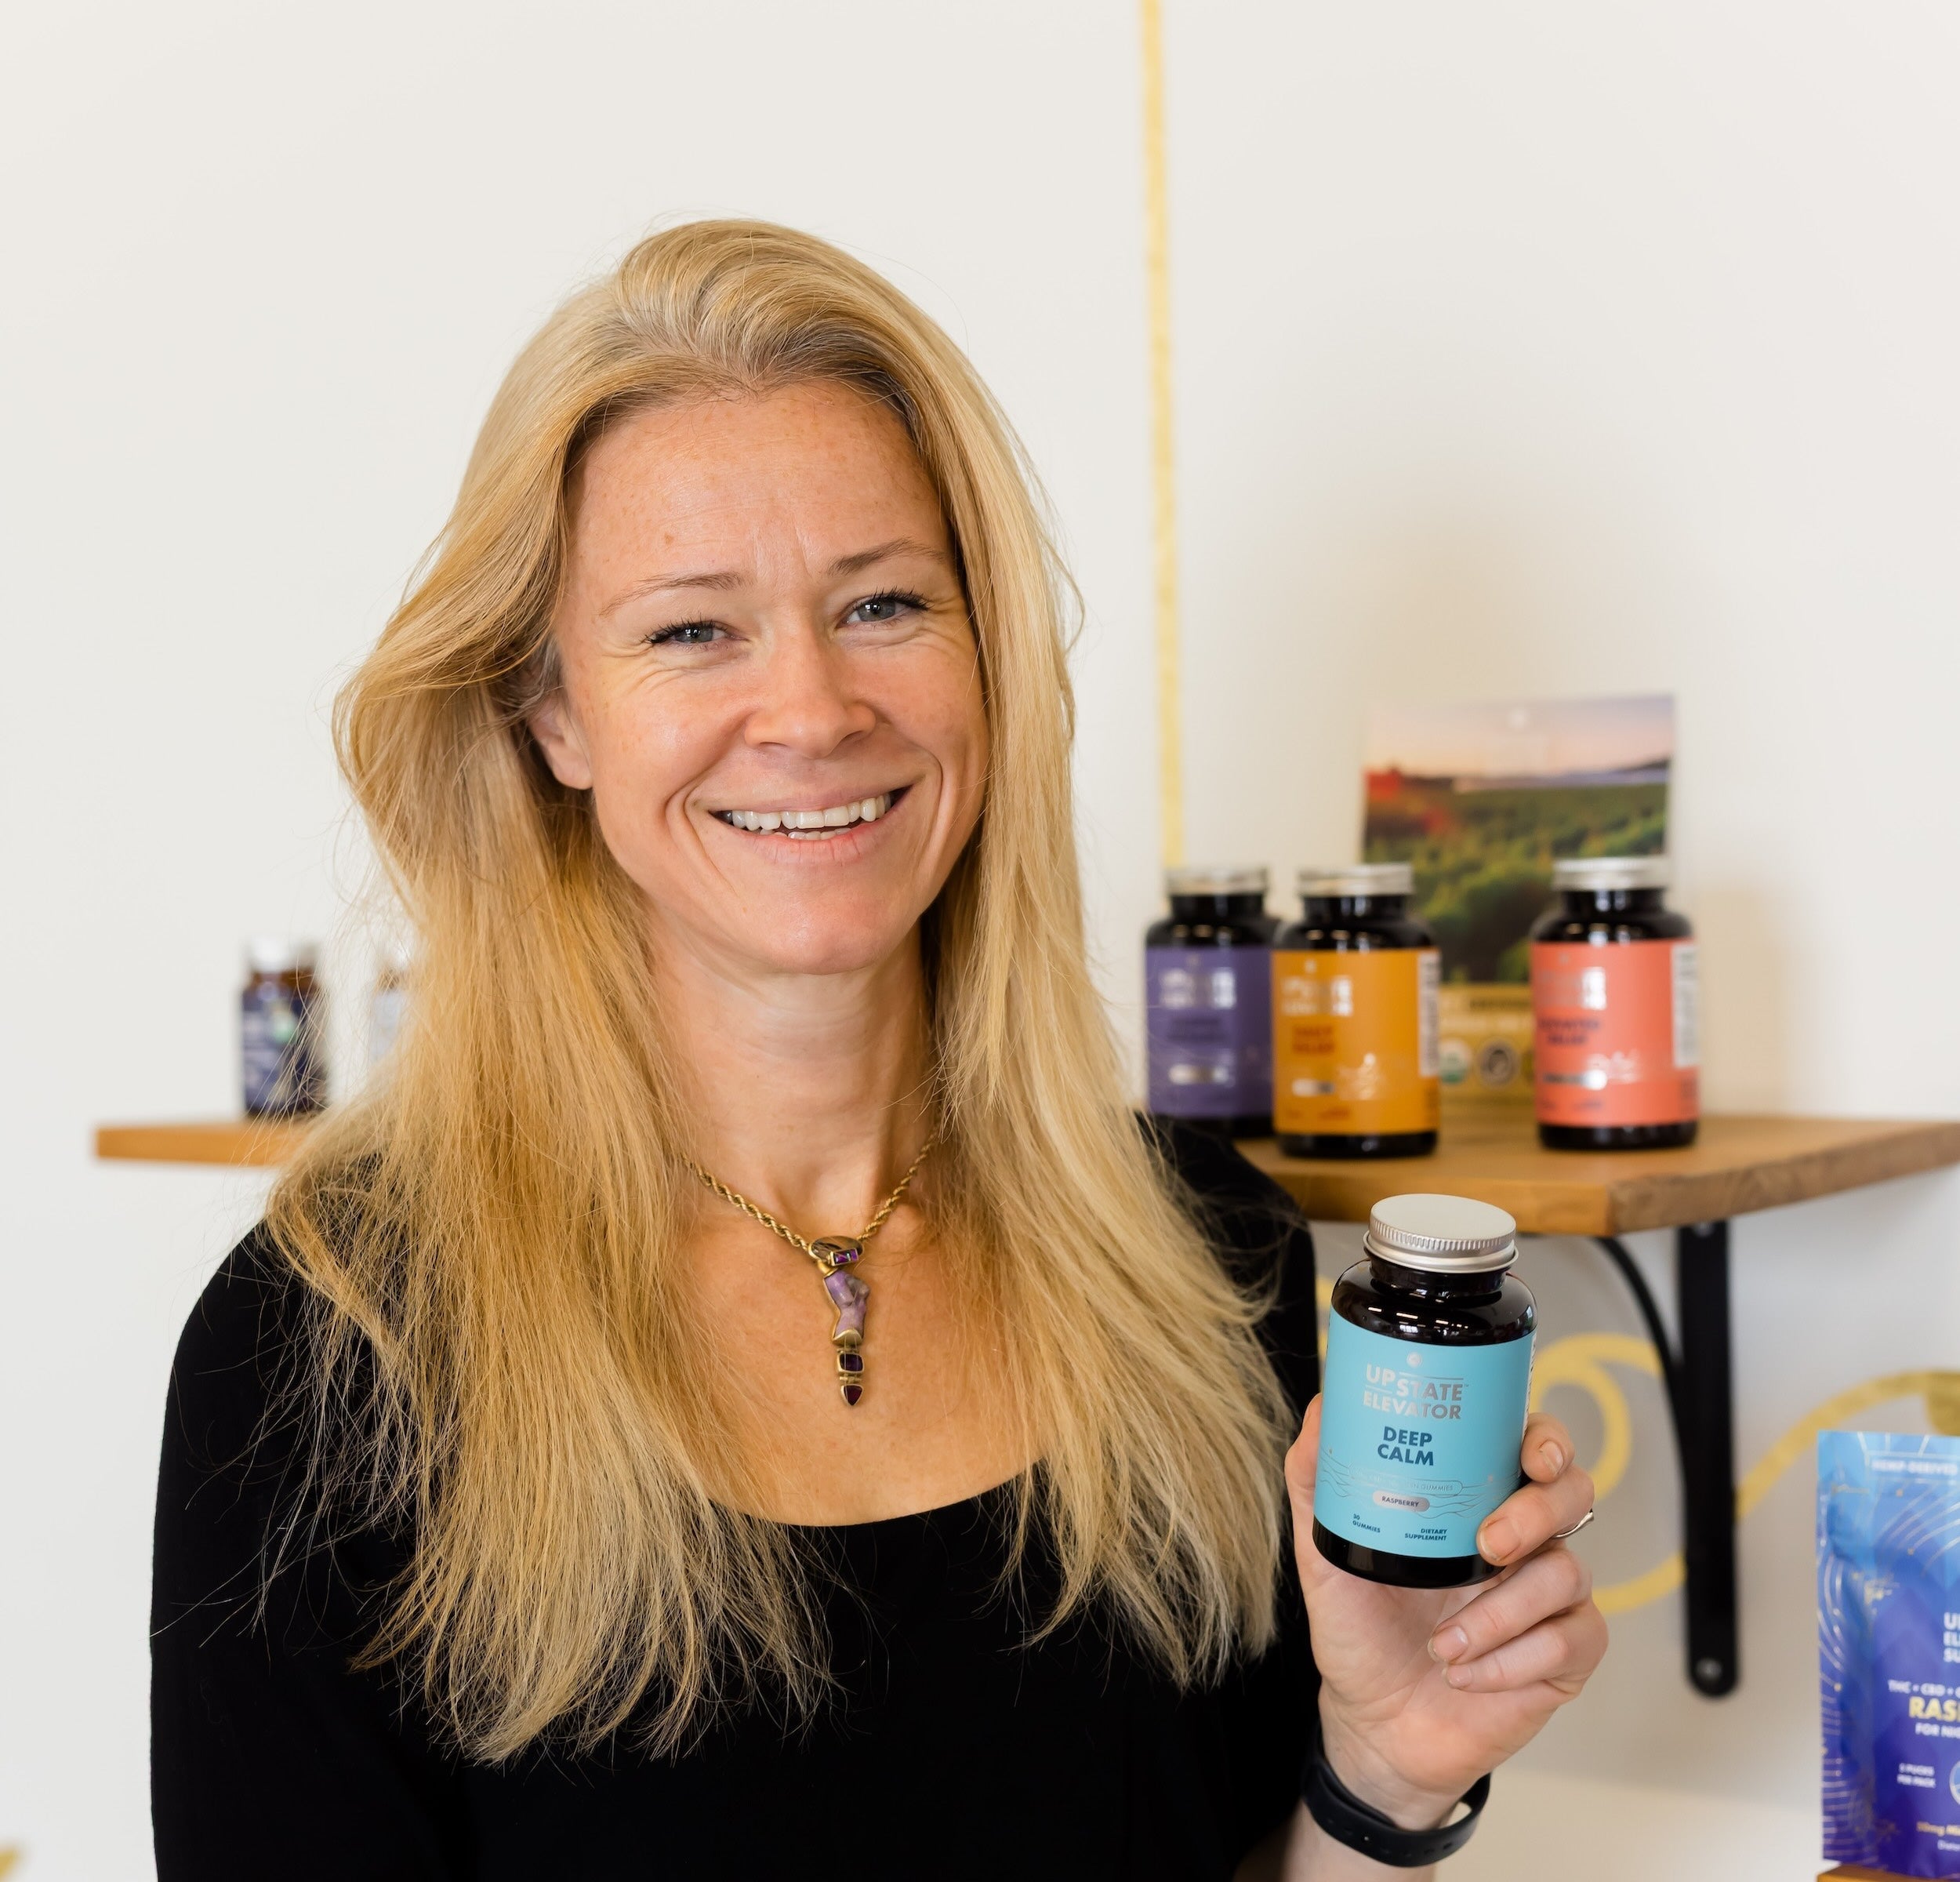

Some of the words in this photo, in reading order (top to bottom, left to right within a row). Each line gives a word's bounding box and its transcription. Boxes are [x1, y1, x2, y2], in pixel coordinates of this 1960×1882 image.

[1363, 1391, 1461, 1419] ELEVATOR
[1383, 1426, 1432, 1447] DEEP
[1377, 1444, 1434, 1466] CALM
[1421, 1483, 1454, 1491] GUMMIES
[1381, 1495, 1419, 1507] RASPBERRY
[1352, 1520, 1381, 1533] GUMMIES
[1915, 1722, 1940, 1737] FOR
